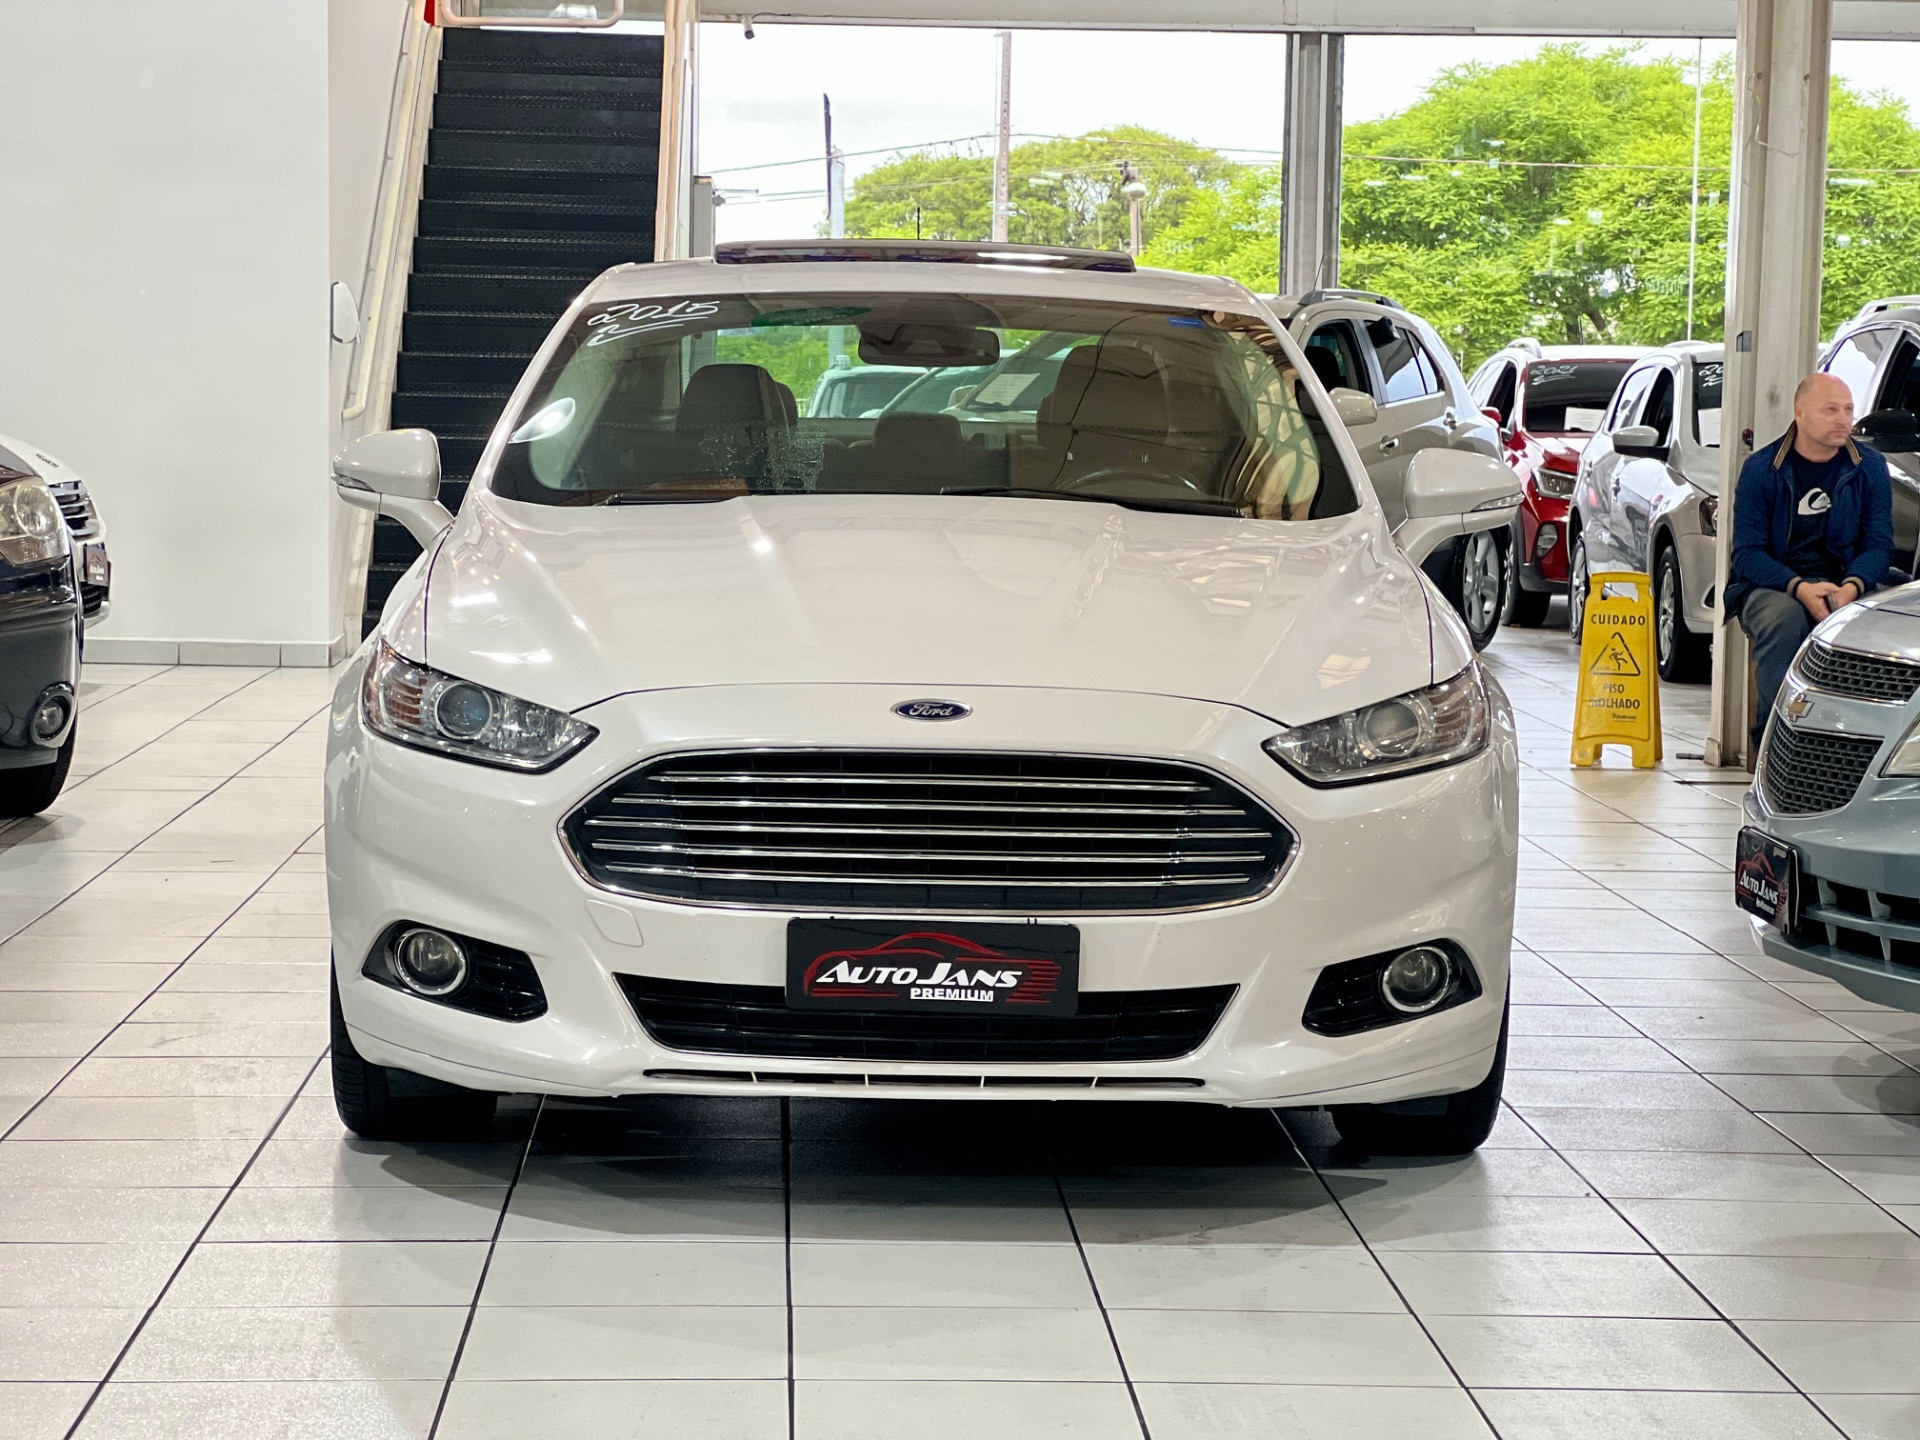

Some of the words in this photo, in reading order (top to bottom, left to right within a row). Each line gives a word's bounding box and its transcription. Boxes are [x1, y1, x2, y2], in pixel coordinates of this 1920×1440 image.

[587, 300, 720, 326] 2015
[1590, 613, 1646, 626] CUIDADO
[1603, 683, 1625, 694] PISO
[909, 703, 954, 716] Ford
[910, 988, 994, 1001] PREMIUM
